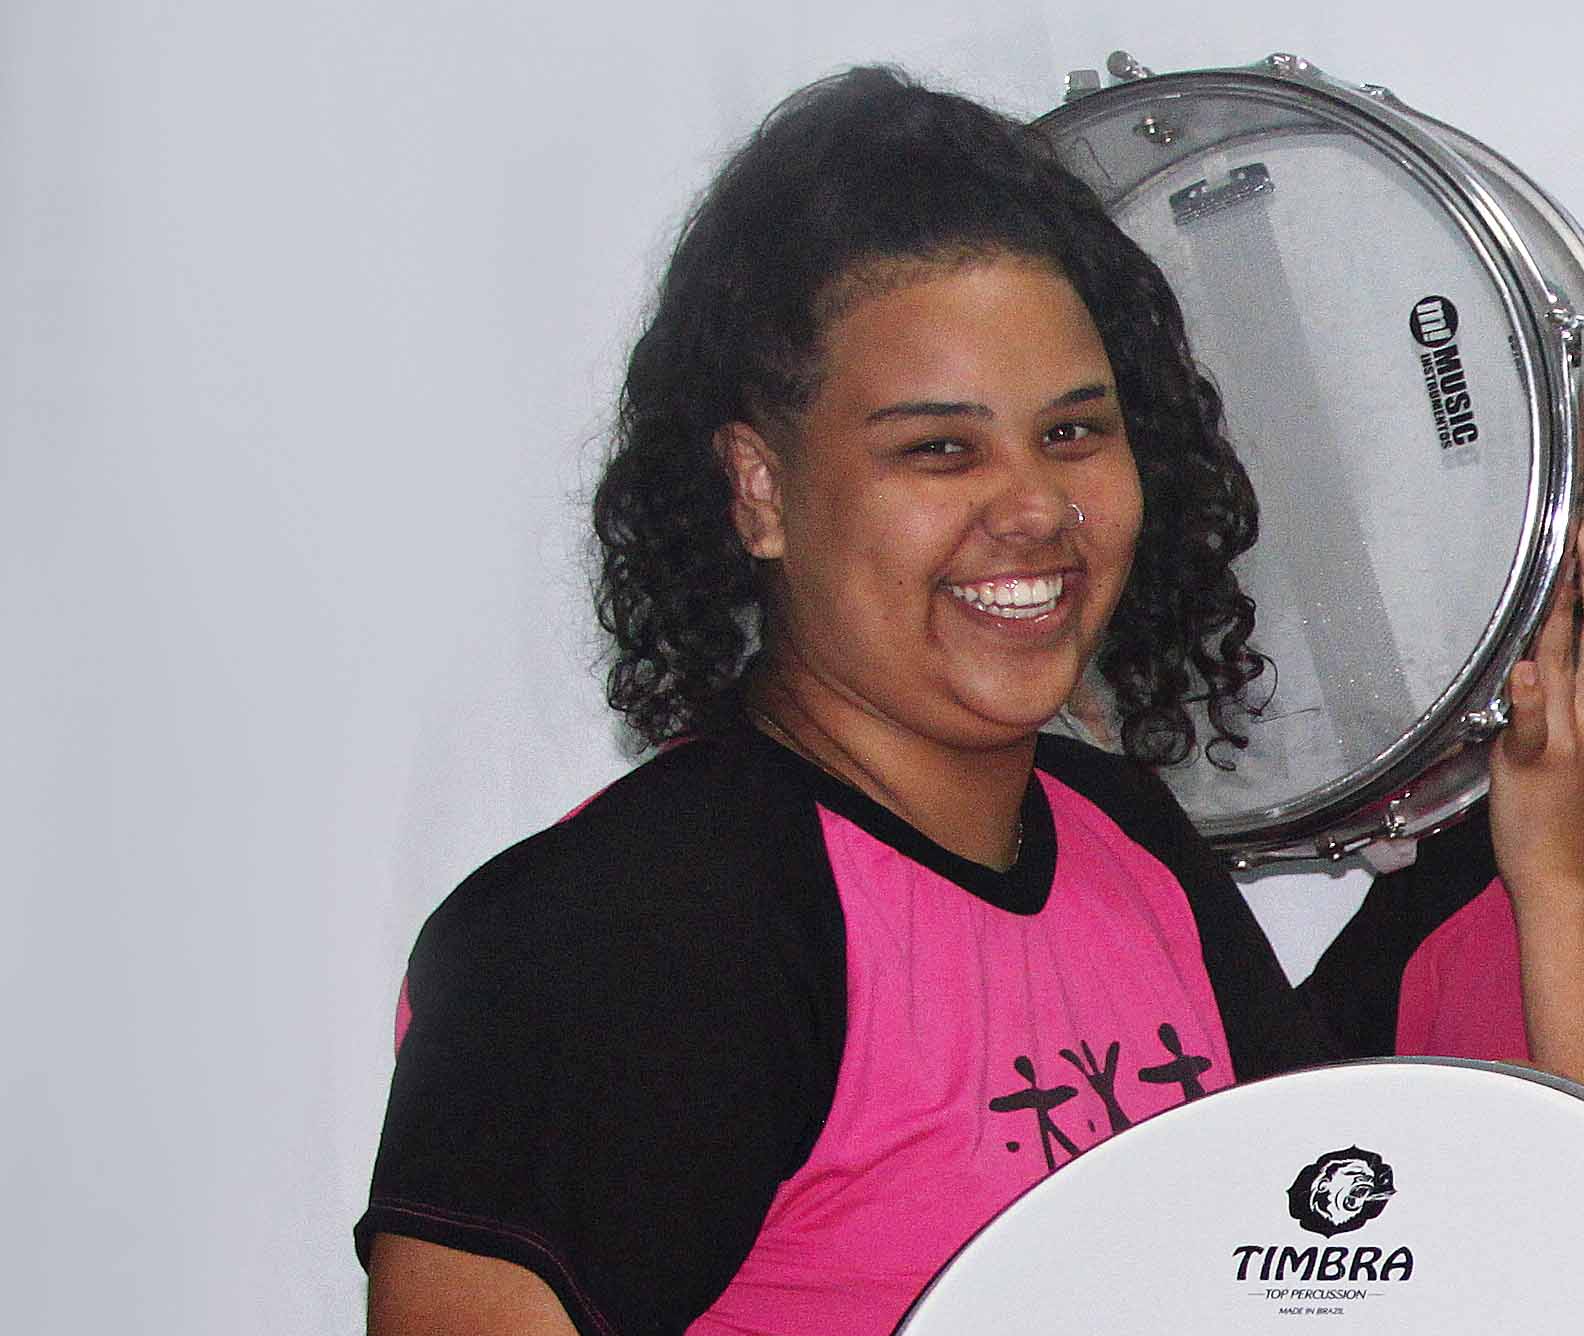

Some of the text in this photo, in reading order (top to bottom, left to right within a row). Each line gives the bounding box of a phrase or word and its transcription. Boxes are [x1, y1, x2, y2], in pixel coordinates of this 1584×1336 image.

[1421, 353, 1453, 450] INSTRUMENTOS
[1433, 343, 1479, 447] MUSIC
[1232, 1245, 1414, 1281] TIMBRA
[1265, 1289, 1367, 1300] TOP PERCUSSION
[1279, 1307, 1344, 1315] MADE IN BRAZIL
